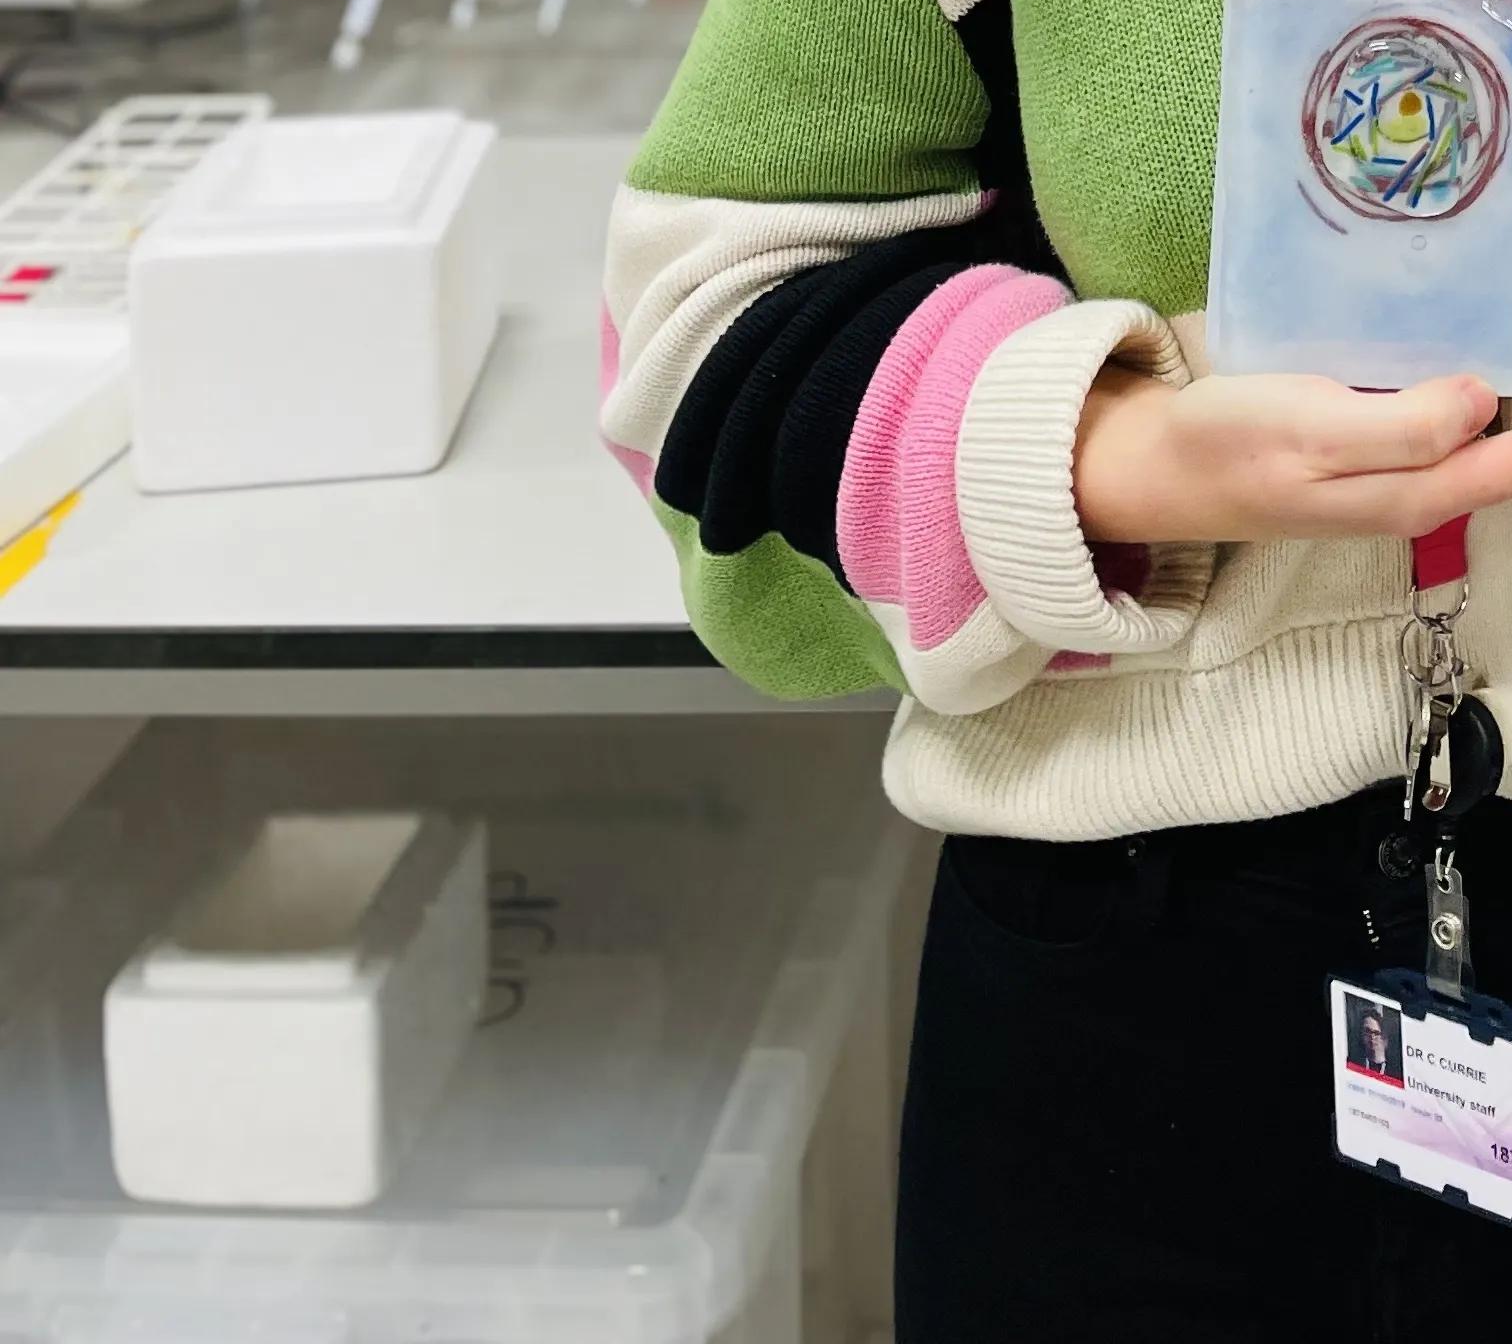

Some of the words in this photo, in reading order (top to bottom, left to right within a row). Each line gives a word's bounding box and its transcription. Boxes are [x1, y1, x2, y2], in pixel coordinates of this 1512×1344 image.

[1406, 1045, 1423, 1061] DR
[1427, 1053, 1436, 1065] C
[1439, 1057, 1487, 1085] CURRIE
[1407, 1075, 1466, 1110] University
[1470, 1101, 1496, 1119] staff
